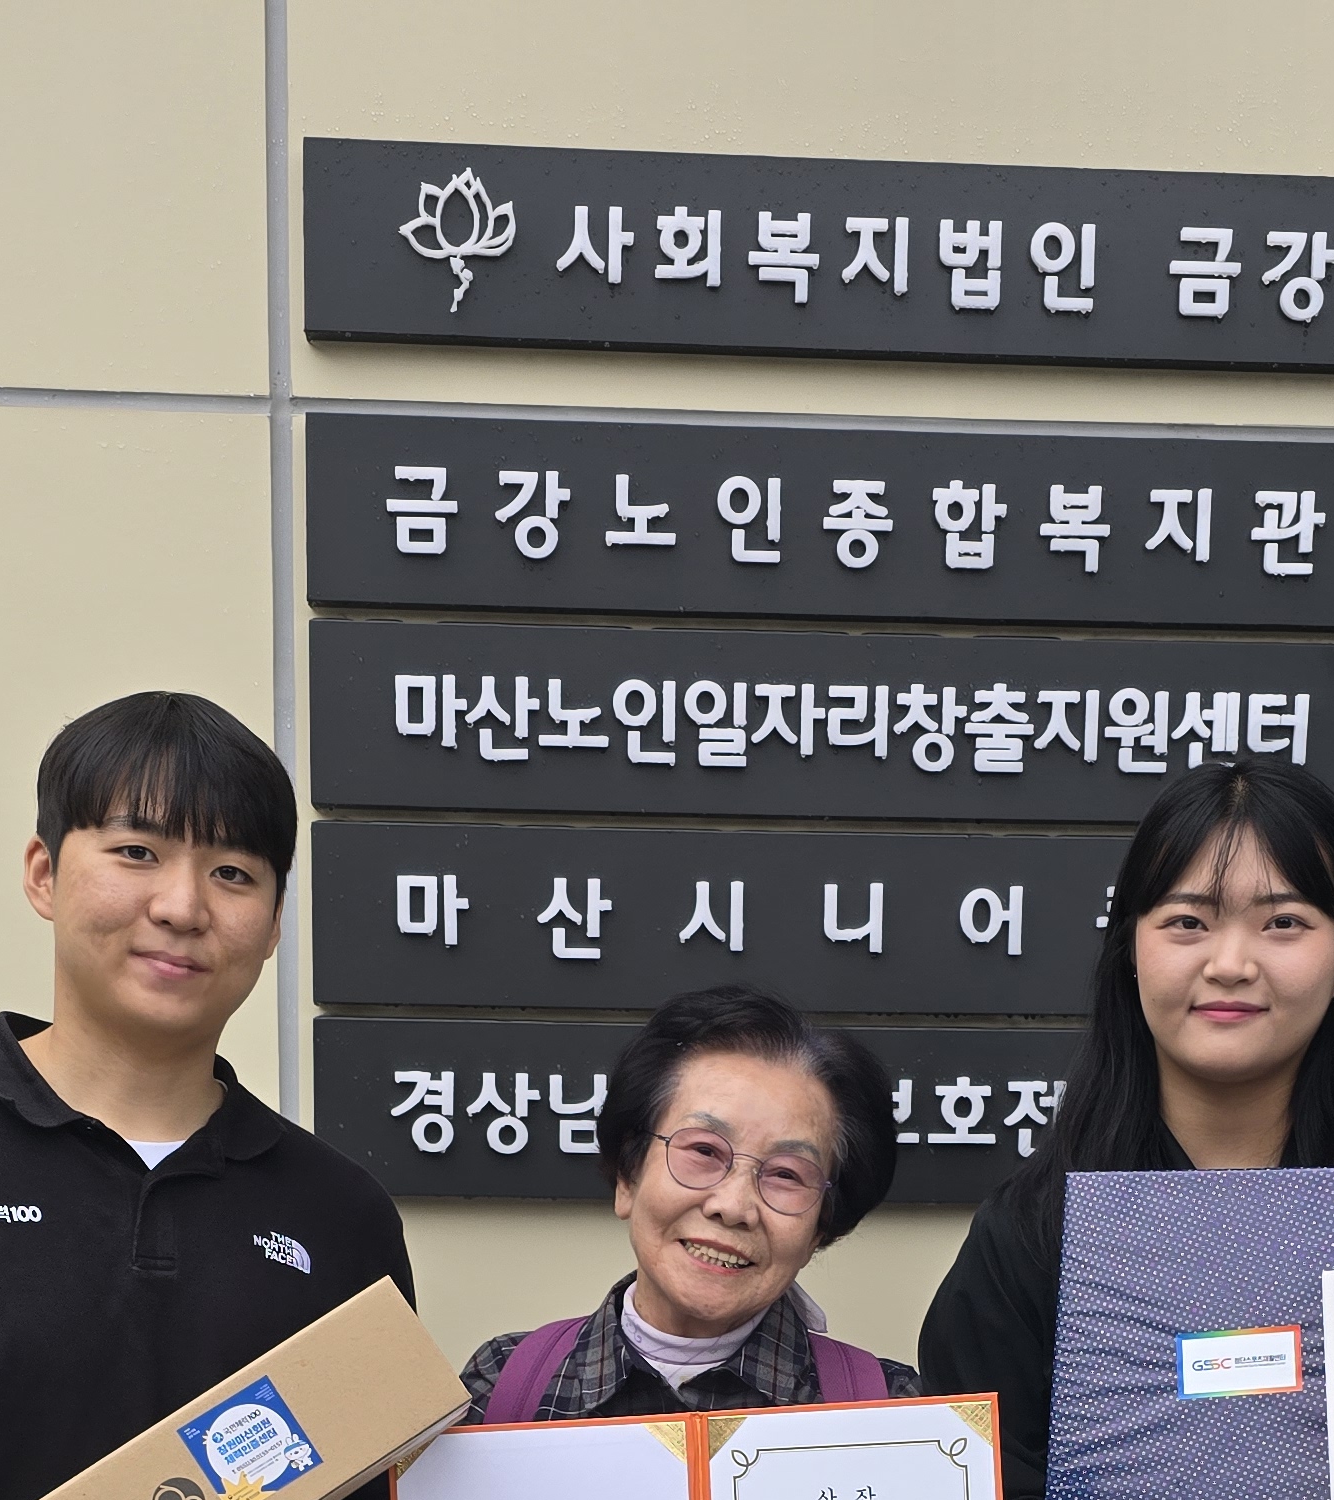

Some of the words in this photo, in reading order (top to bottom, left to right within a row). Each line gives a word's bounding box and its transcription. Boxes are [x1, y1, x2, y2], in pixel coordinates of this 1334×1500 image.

[556, 204, 1097, 315] 사회복지법인
[385, 464, 1327, 578] 금강노인종합복지관
[394, 673, 1311, 774] 마산노인일자리창출지원센터
[395, 873, 1116, 960] 마산시니어
[253, 1234, 294, 1256] NORTH
[270, 1231, 293, 1247] THE
[265, 1248, 295, 1267] FACE
[1192, 1357, 1232, 1372] GSSC
[223, 1409, 262, 1435] 국민체력100
